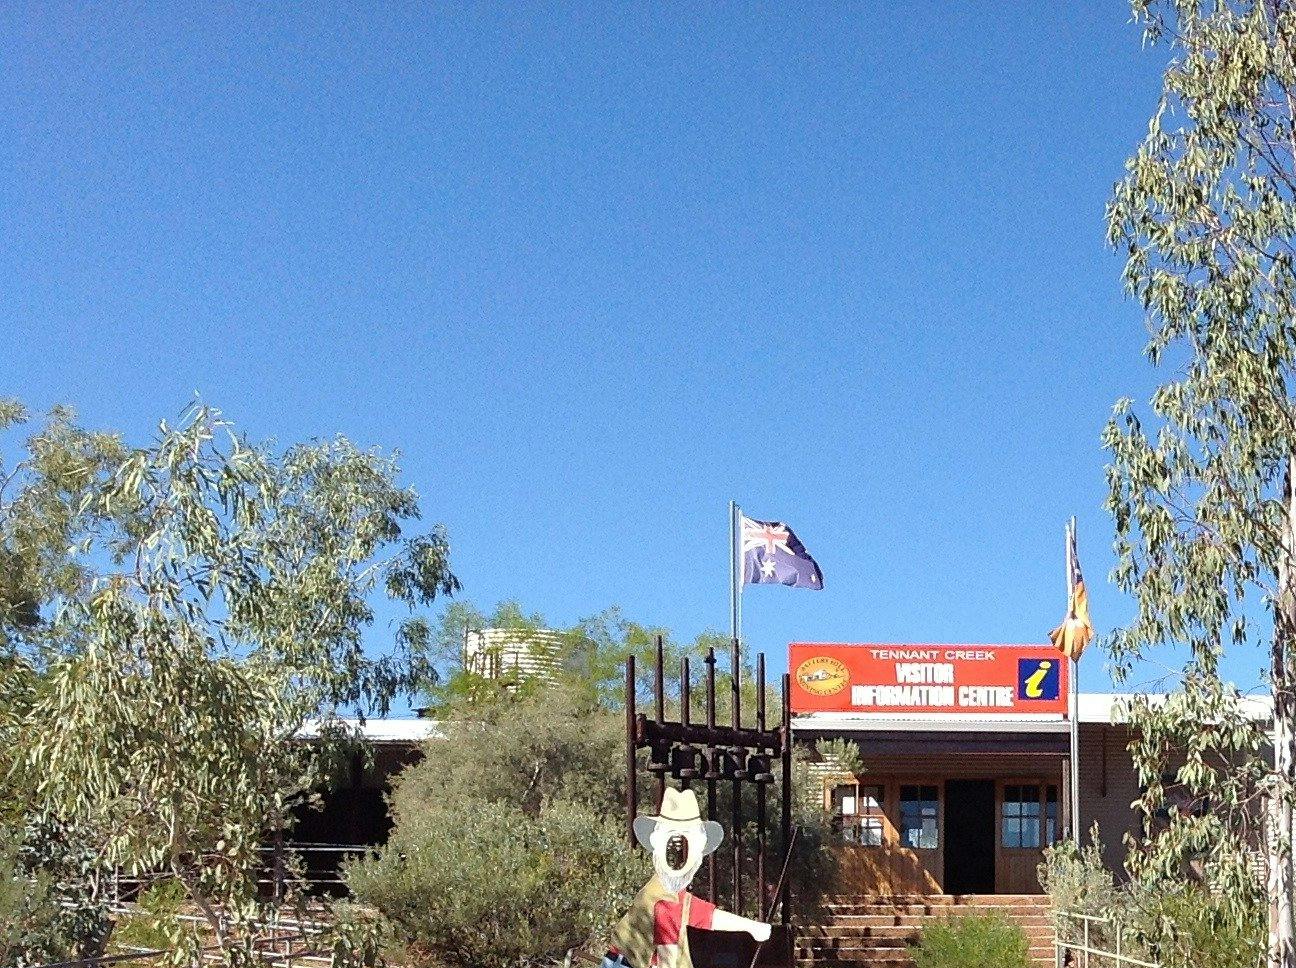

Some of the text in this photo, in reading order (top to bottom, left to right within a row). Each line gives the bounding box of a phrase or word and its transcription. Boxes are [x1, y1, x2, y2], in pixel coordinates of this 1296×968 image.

[870, 649, 995, 661] TENNANT CREEK
[895, 662, 954, 684] VISITOR
[851, 685, 1015, 707] INFORMATION CENTRE
